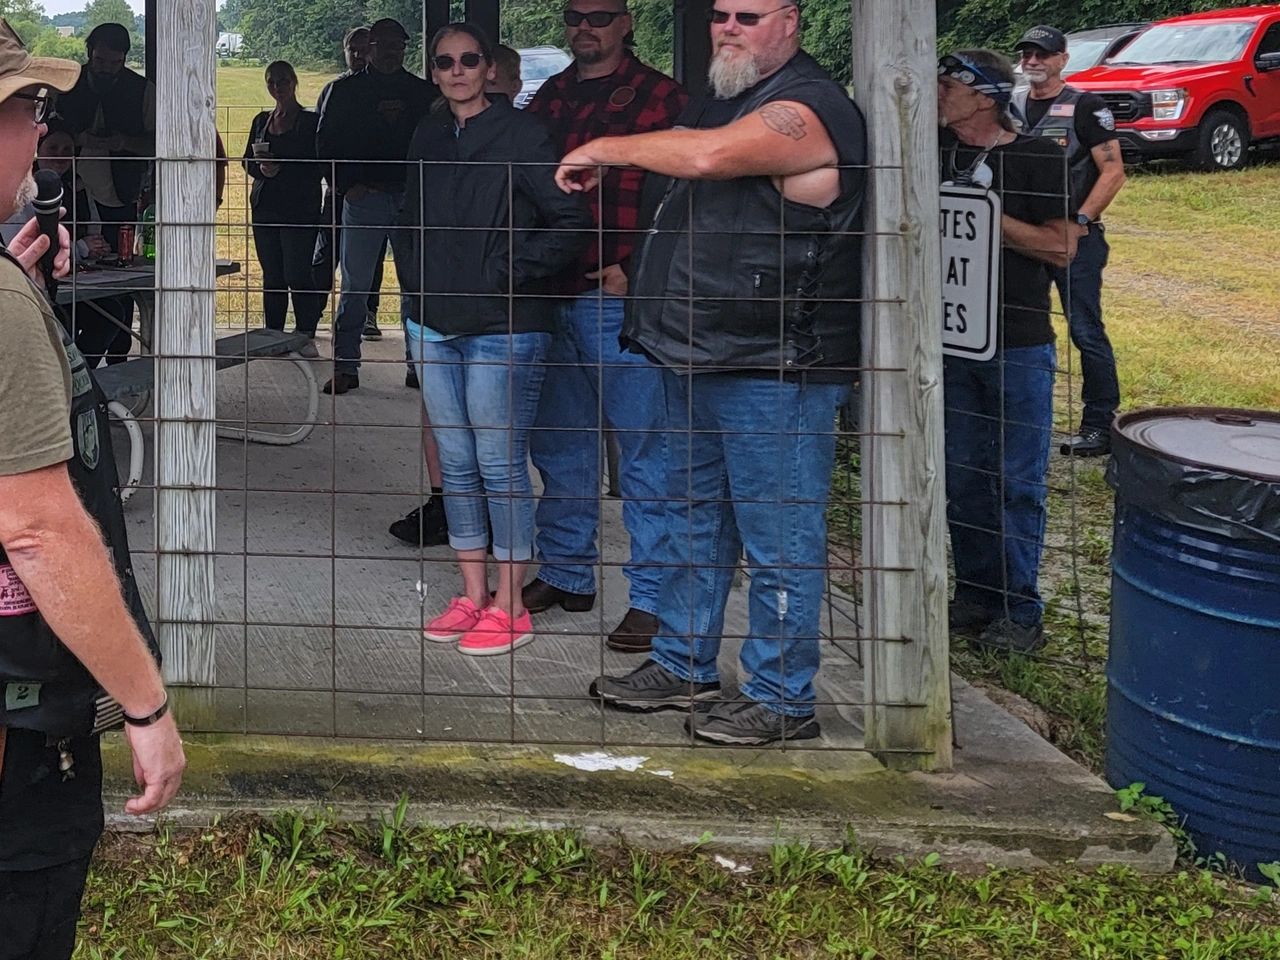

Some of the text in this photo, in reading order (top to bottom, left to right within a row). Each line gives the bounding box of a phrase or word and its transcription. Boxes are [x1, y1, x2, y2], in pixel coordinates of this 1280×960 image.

[941, 209, 976, 241] TES
[946, 256, 970, 286] AT
[943, 302, 967, 334] ES
[15, 685, 30, 702] 2
